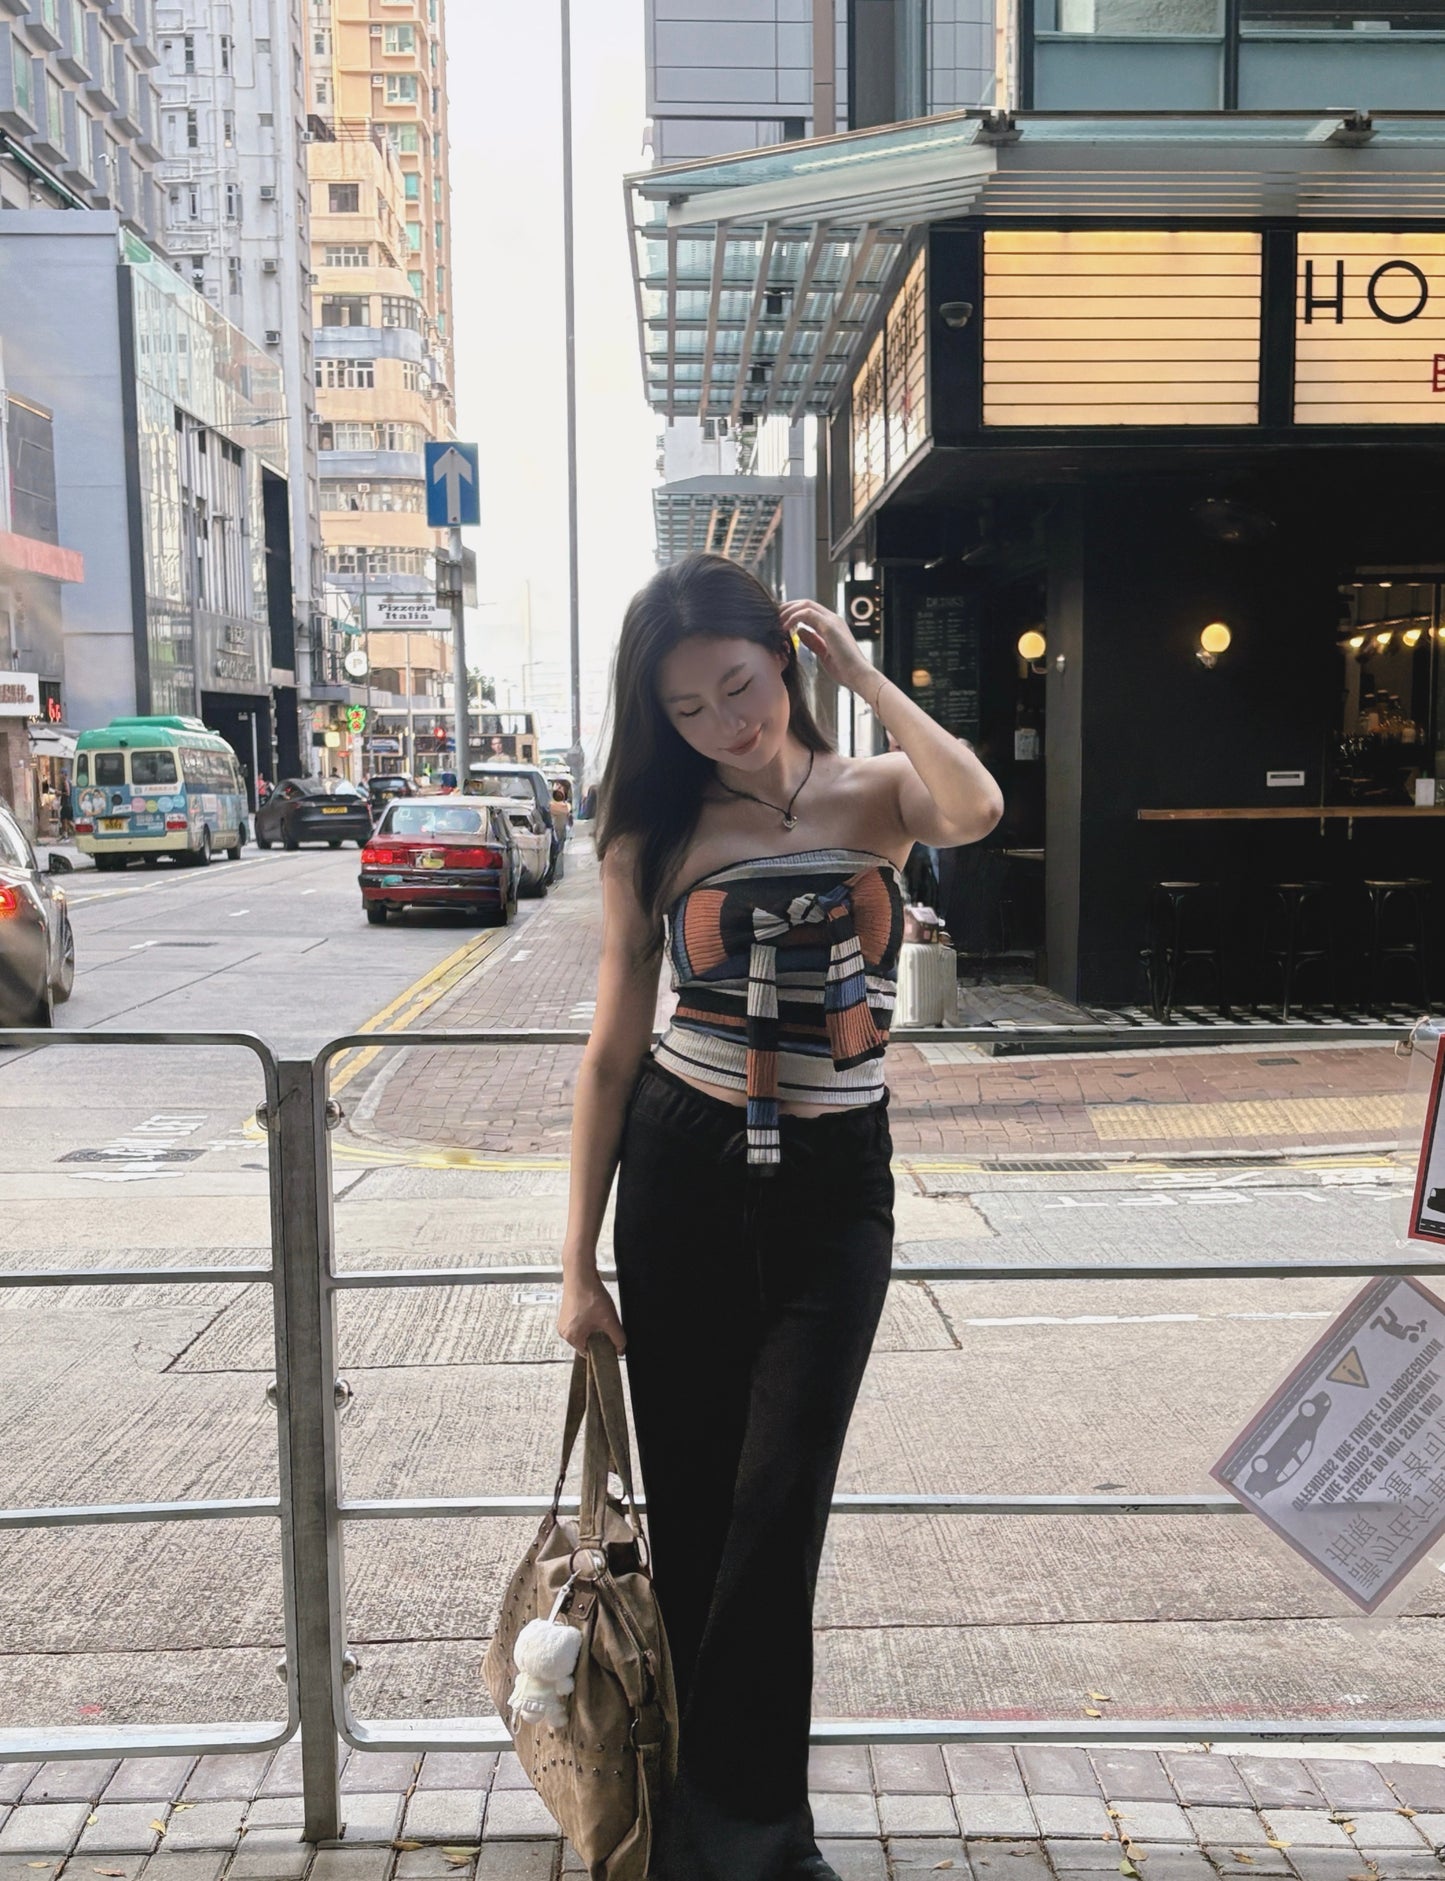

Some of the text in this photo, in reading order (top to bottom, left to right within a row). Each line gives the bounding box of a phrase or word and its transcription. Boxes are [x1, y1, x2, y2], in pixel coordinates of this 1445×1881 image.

[1304, 260, 1428, 324] HO
[377, 604, 436, 612] Pizzeria
[385, 612, 429, 620] Italia
[1043, 1192, 1326, 1207] LEFT
